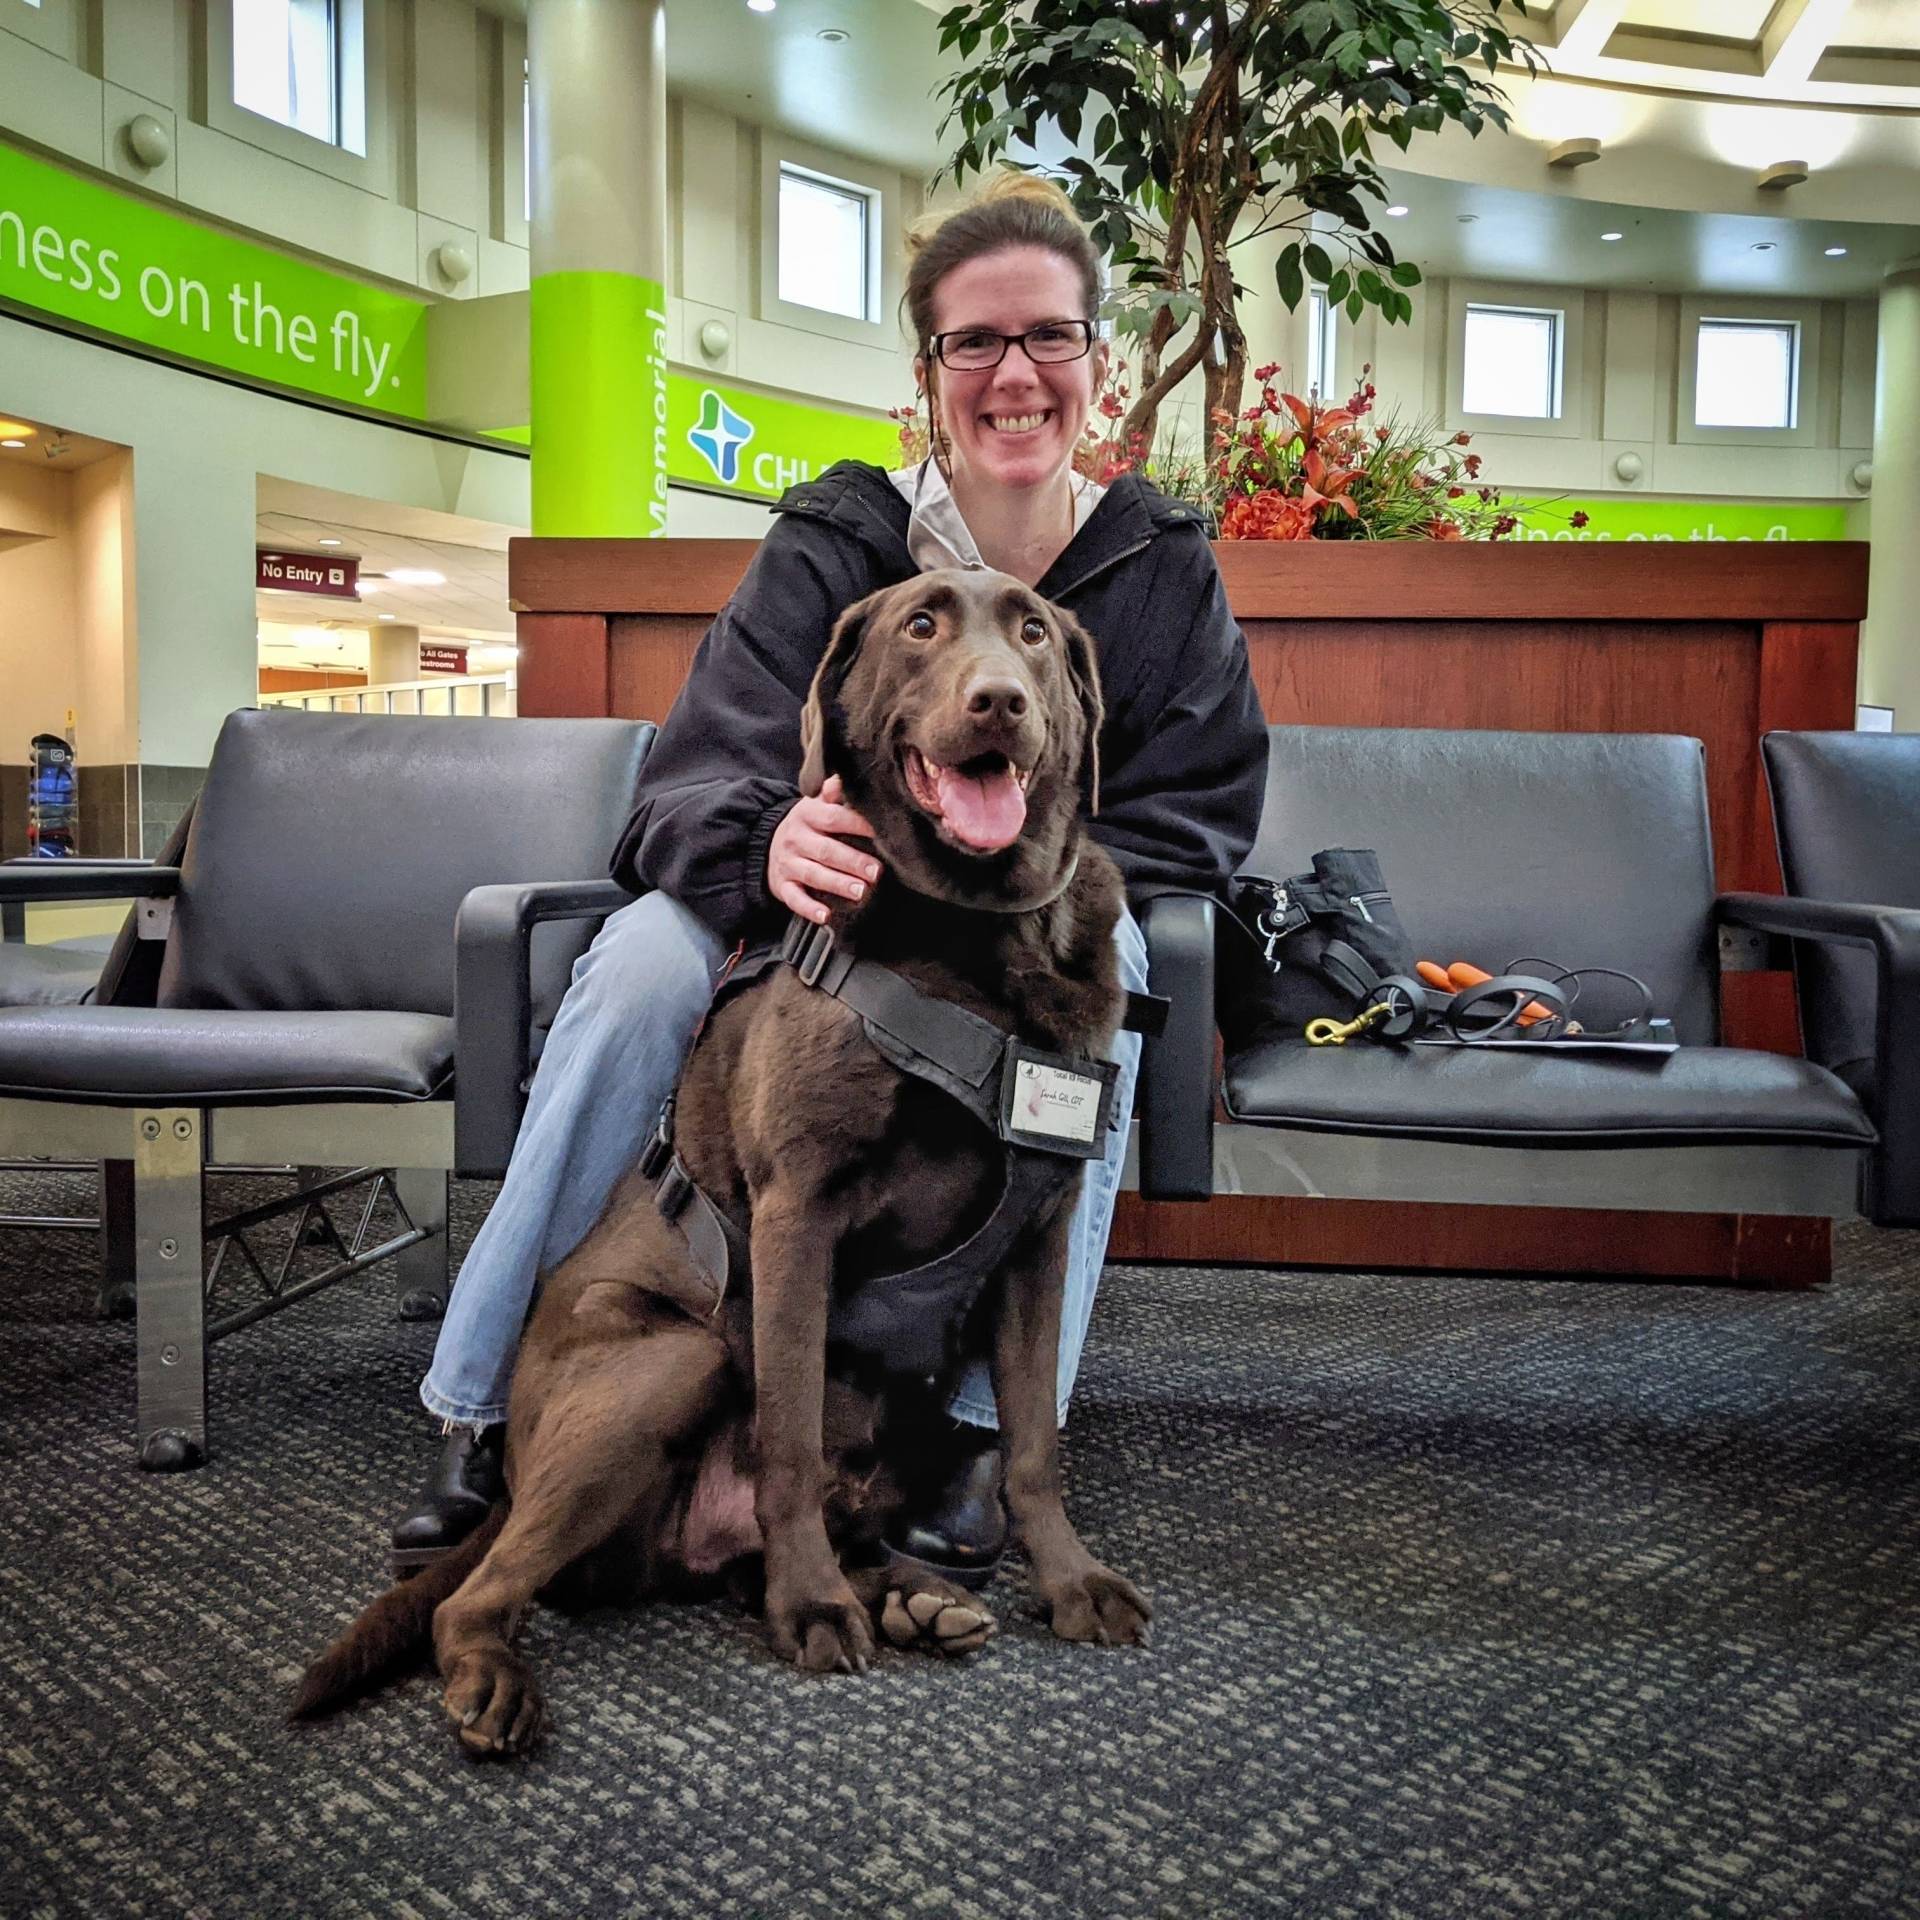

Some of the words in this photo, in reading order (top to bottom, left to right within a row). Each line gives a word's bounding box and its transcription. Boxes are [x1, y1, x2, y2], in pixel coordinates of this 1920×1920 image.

[0, 211, 121, 301] ness
[139, 266, 210, 333] on
[228, 281, 318, 363] the
[330, 310, 400, 397] fly.
[753, 452, 808, 490] CHI
[262, 562, 283, 578] No
[286, 565, 324, 586] Entry
[426, 650, 437, 658] All
[437, 650, 459, 660] Gates
